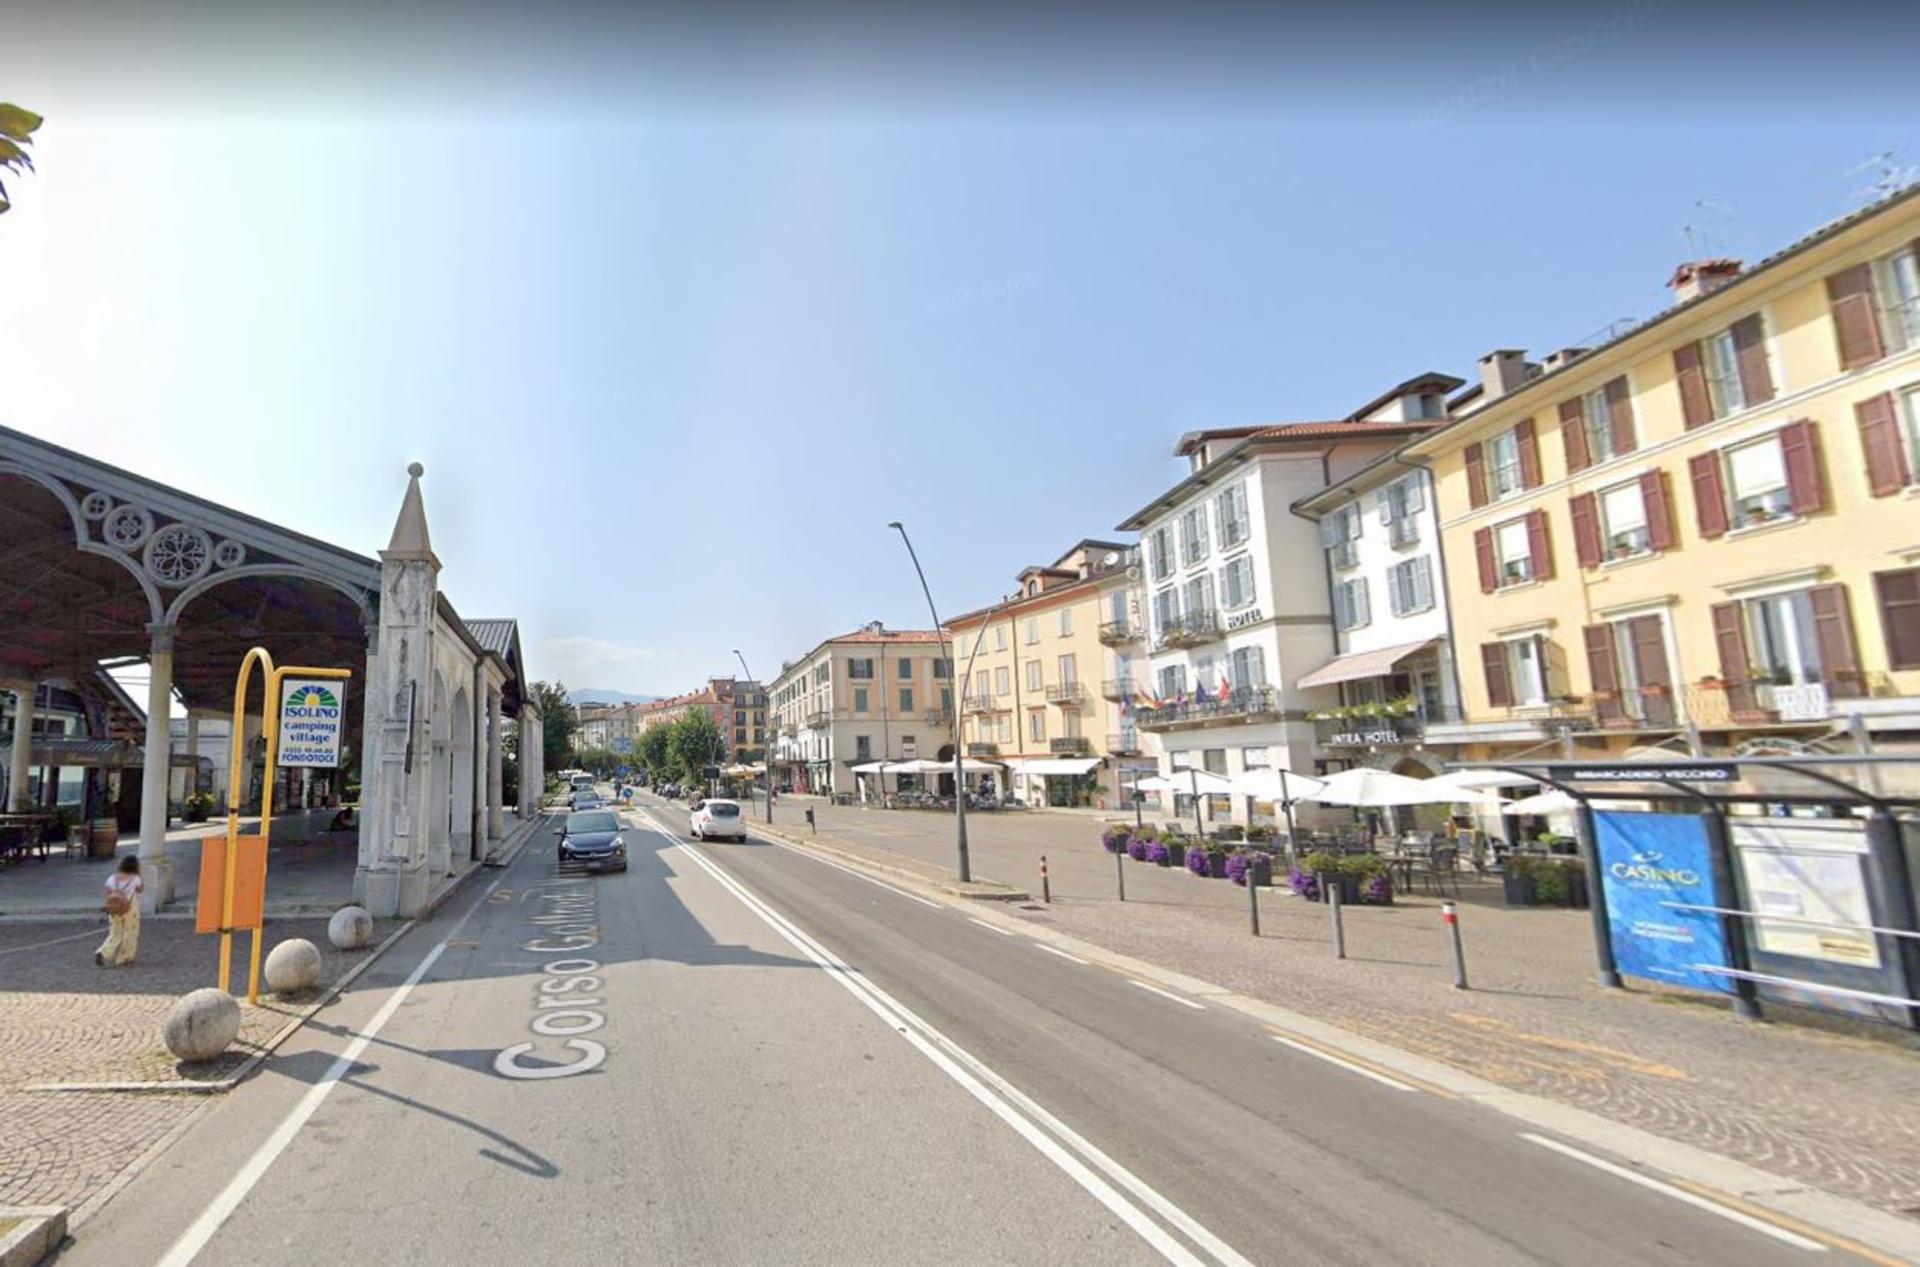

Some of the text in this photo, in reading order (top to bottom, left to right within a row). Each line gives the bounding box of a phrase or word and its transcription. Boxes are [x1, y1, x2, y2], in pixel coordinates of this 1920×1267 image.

[1228, 608, 1263, 629] HOTEL
[284, 707, 338, 718] ISOLINO
[284, 722, 337, 732] camping
[290, 733, 330, 744] village
[1365, 730, 1400, 744] HOTEL
[1610, 861, 1700, 885] CASINO
